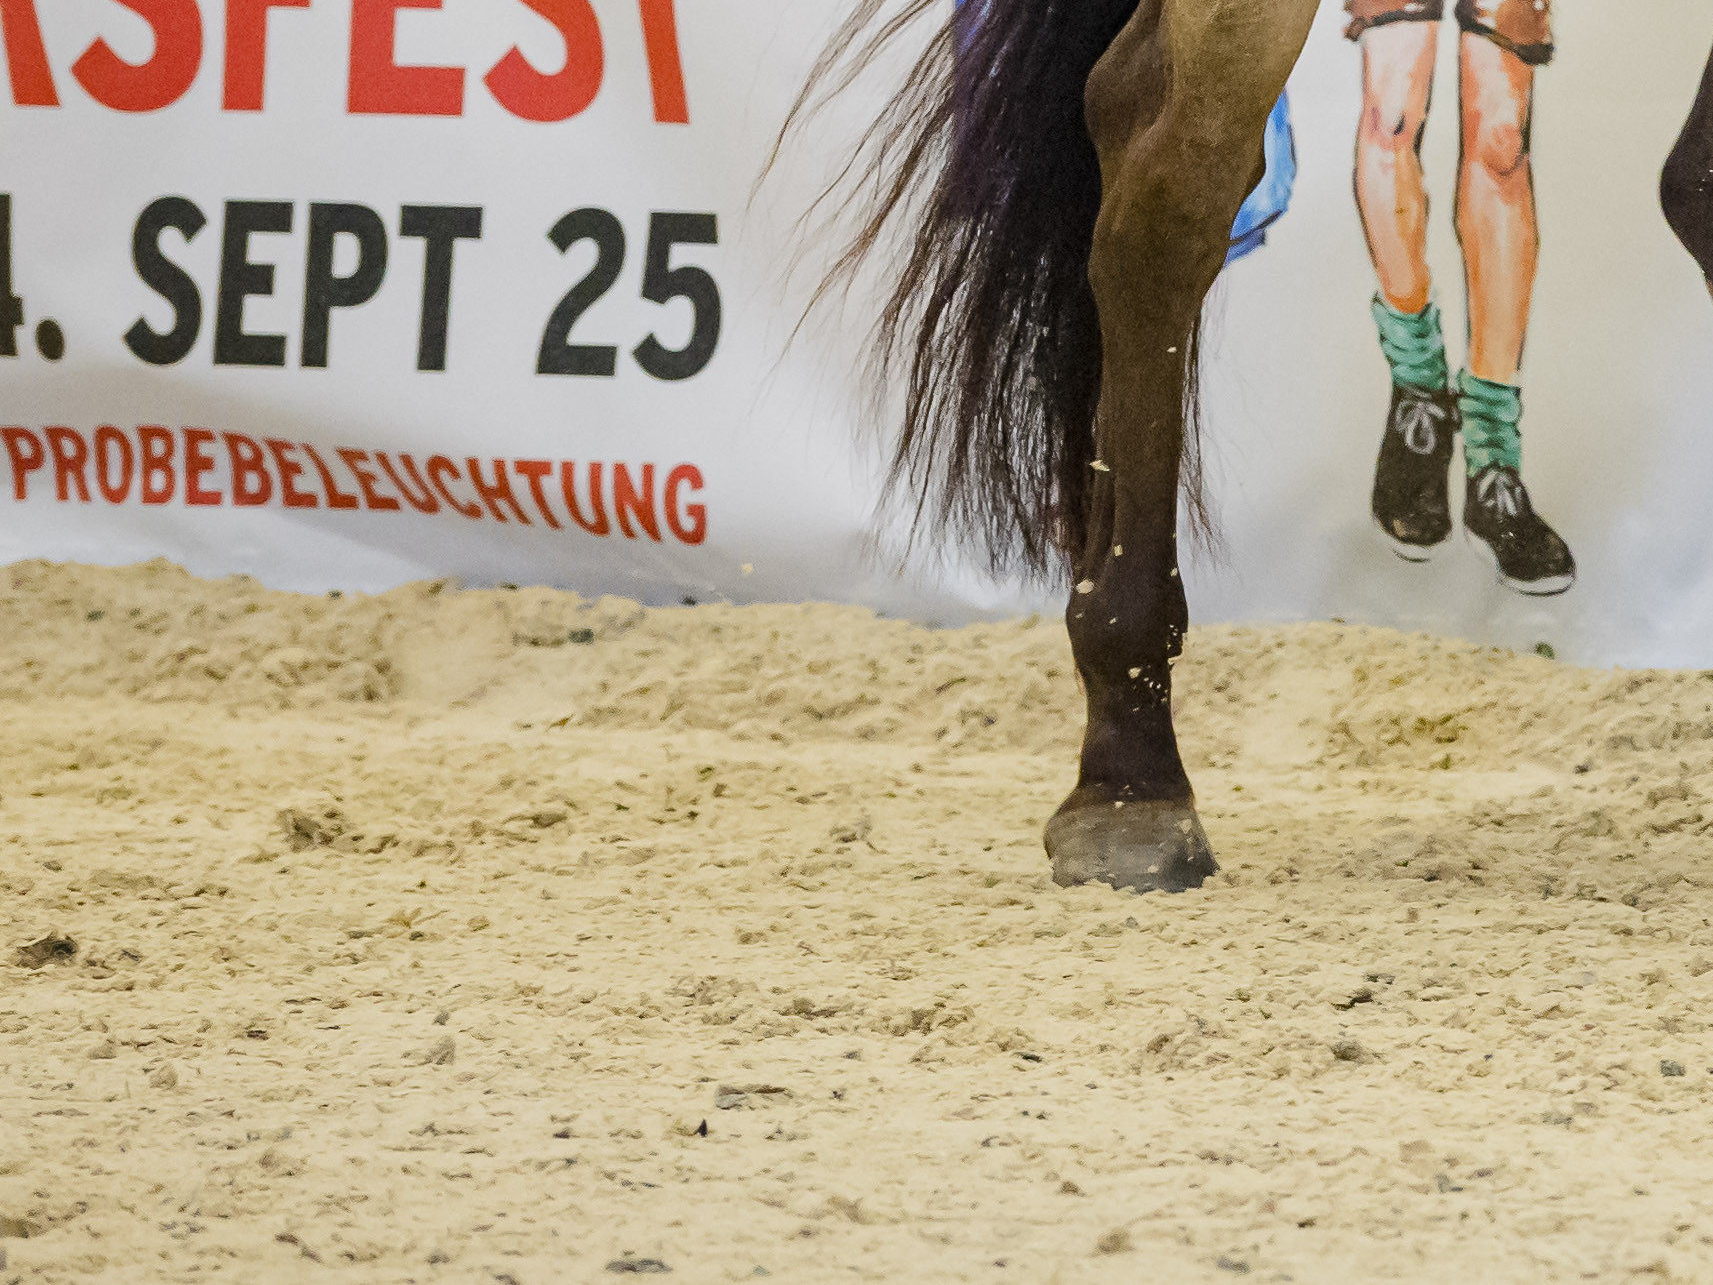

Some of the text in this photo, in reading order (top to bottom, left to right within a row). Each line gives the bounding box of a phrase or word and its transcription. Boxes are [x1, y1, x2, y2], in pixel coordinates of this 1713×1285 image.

[124, 195, 484, 374] SEPT
[534, 206, 723, 381] 25
[0, 425, 708, 547] PROBEBELEUCHTUNG
